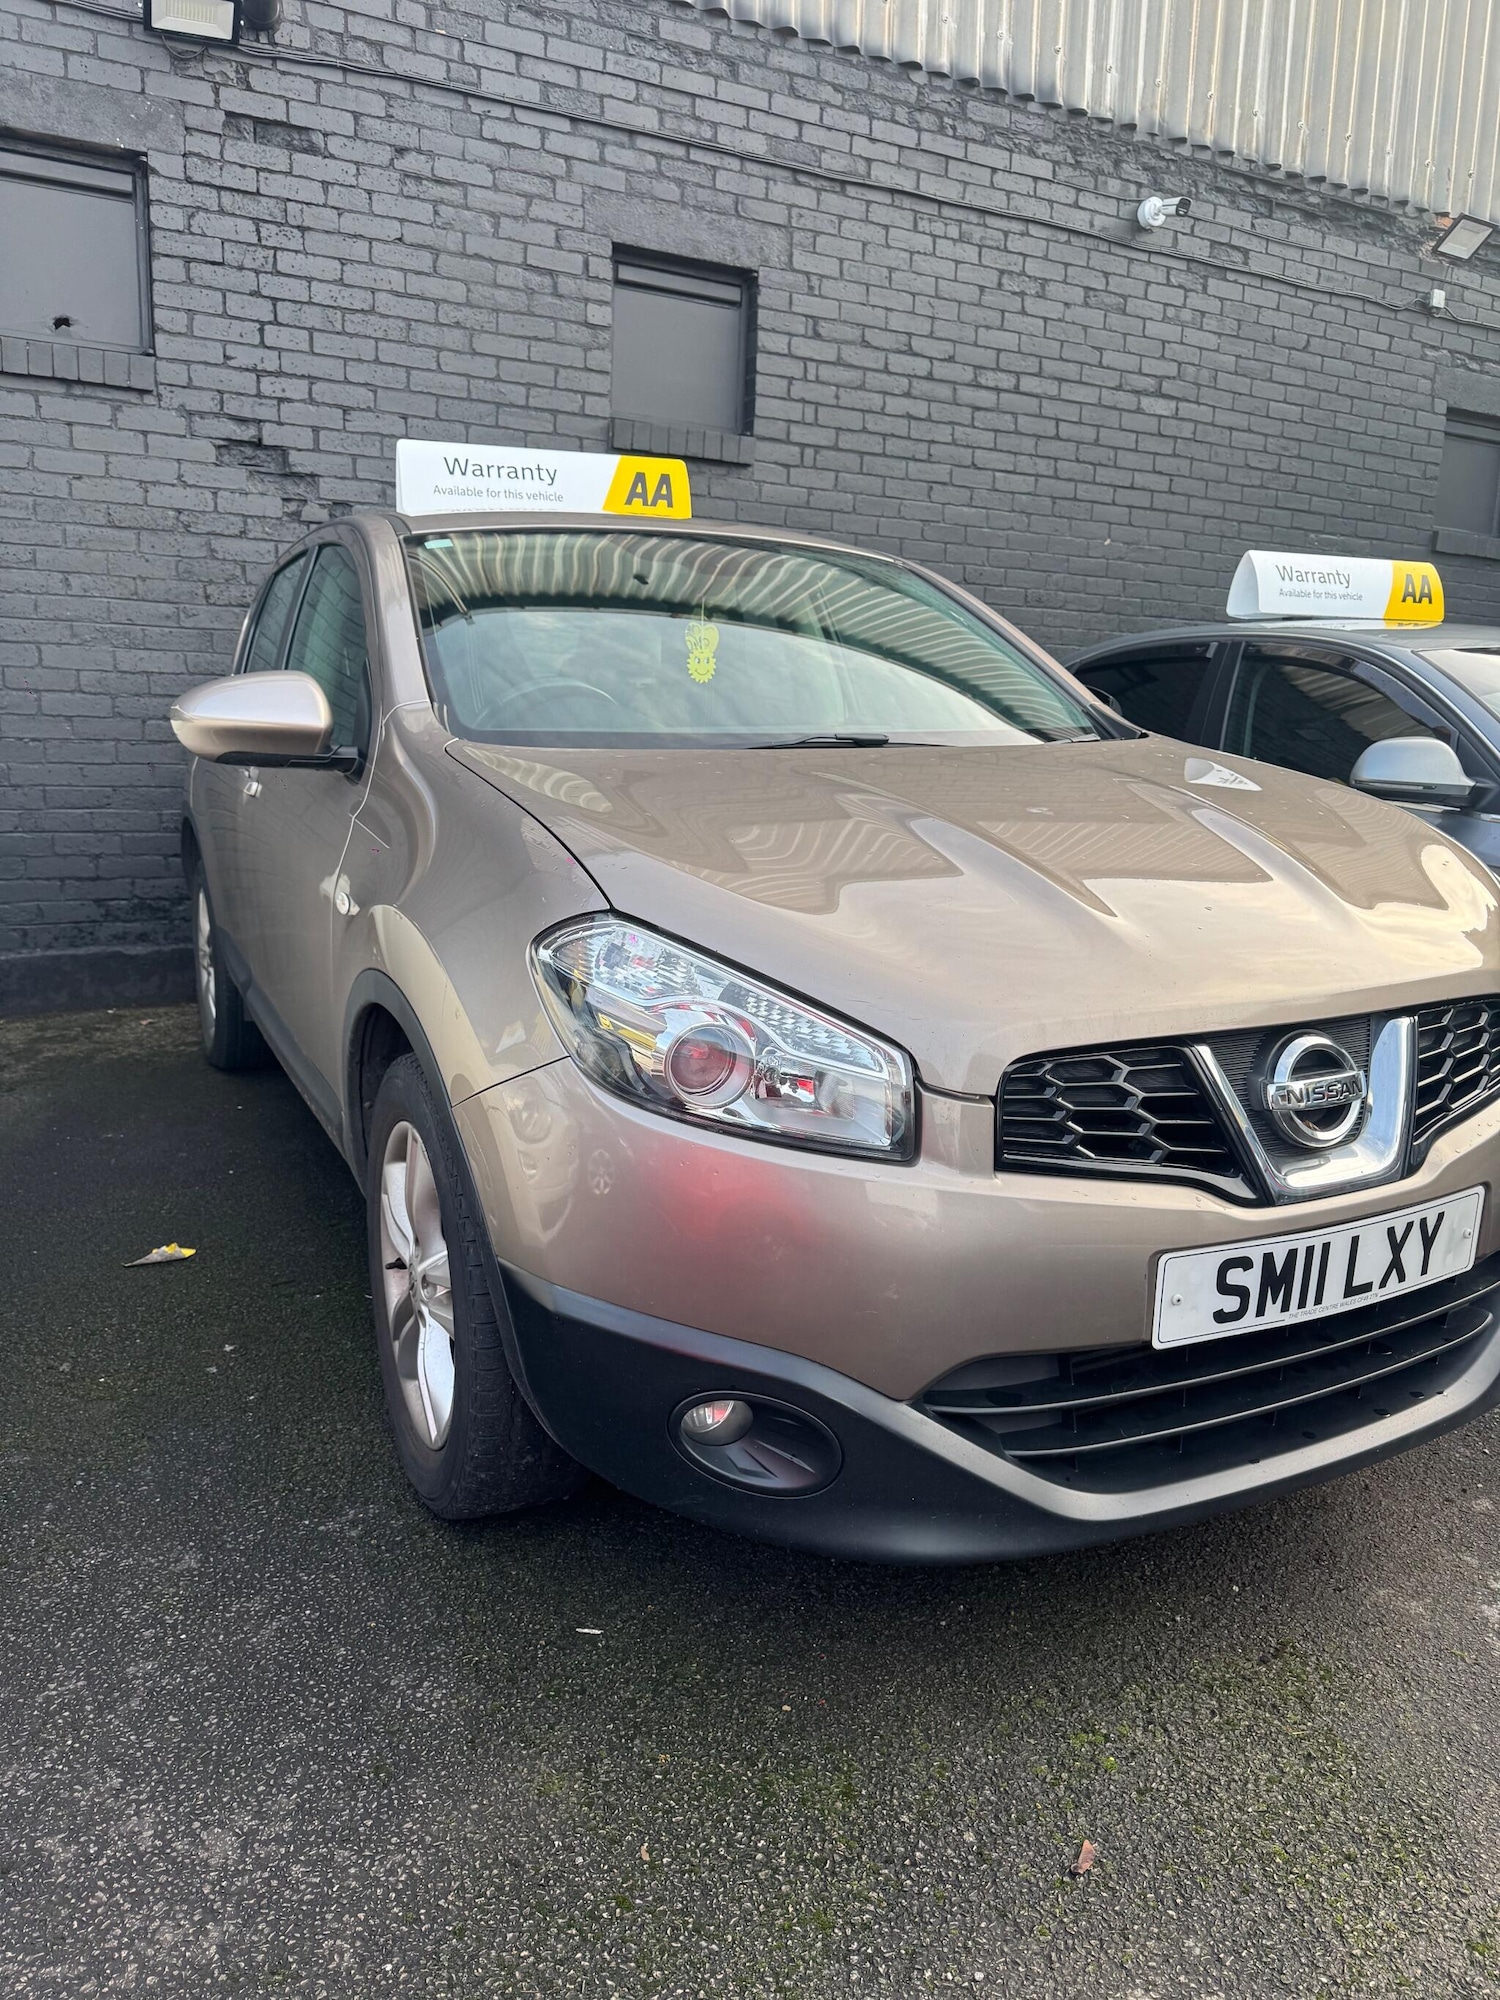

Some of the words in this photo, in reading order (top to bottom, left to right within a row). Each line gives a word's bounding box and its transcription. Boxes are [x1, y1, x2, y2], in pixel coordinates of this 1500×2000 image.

[443, 456, 557, 486] Warranty
[433, 485, 484, 498] Available
[486, 488, 501, 499] for
[504, 489, 524, 500] this
[525, 490, 564, 503] vehicle
[624, 471, 674, 508] AA
[1275, 564, 1351, 589] Warranty
[1401, 573, 1433, 605] AA
[1279, 588, 1312, 599] Available
[1313, 590, 1323, 599] for
[1324, 590, 1337, 600] this
[1338, 591, 1363, 602] vehicle
[1283, 1078, 1363, 1105] NISSAN
[1343, 1211, 1445, 1299] LXY
[1300, 1307, 1318, 1317] TRADE
[1318, 1302, 1339, 1313] CENTRE
[1339, 1297, 1357, 1308] WALES
